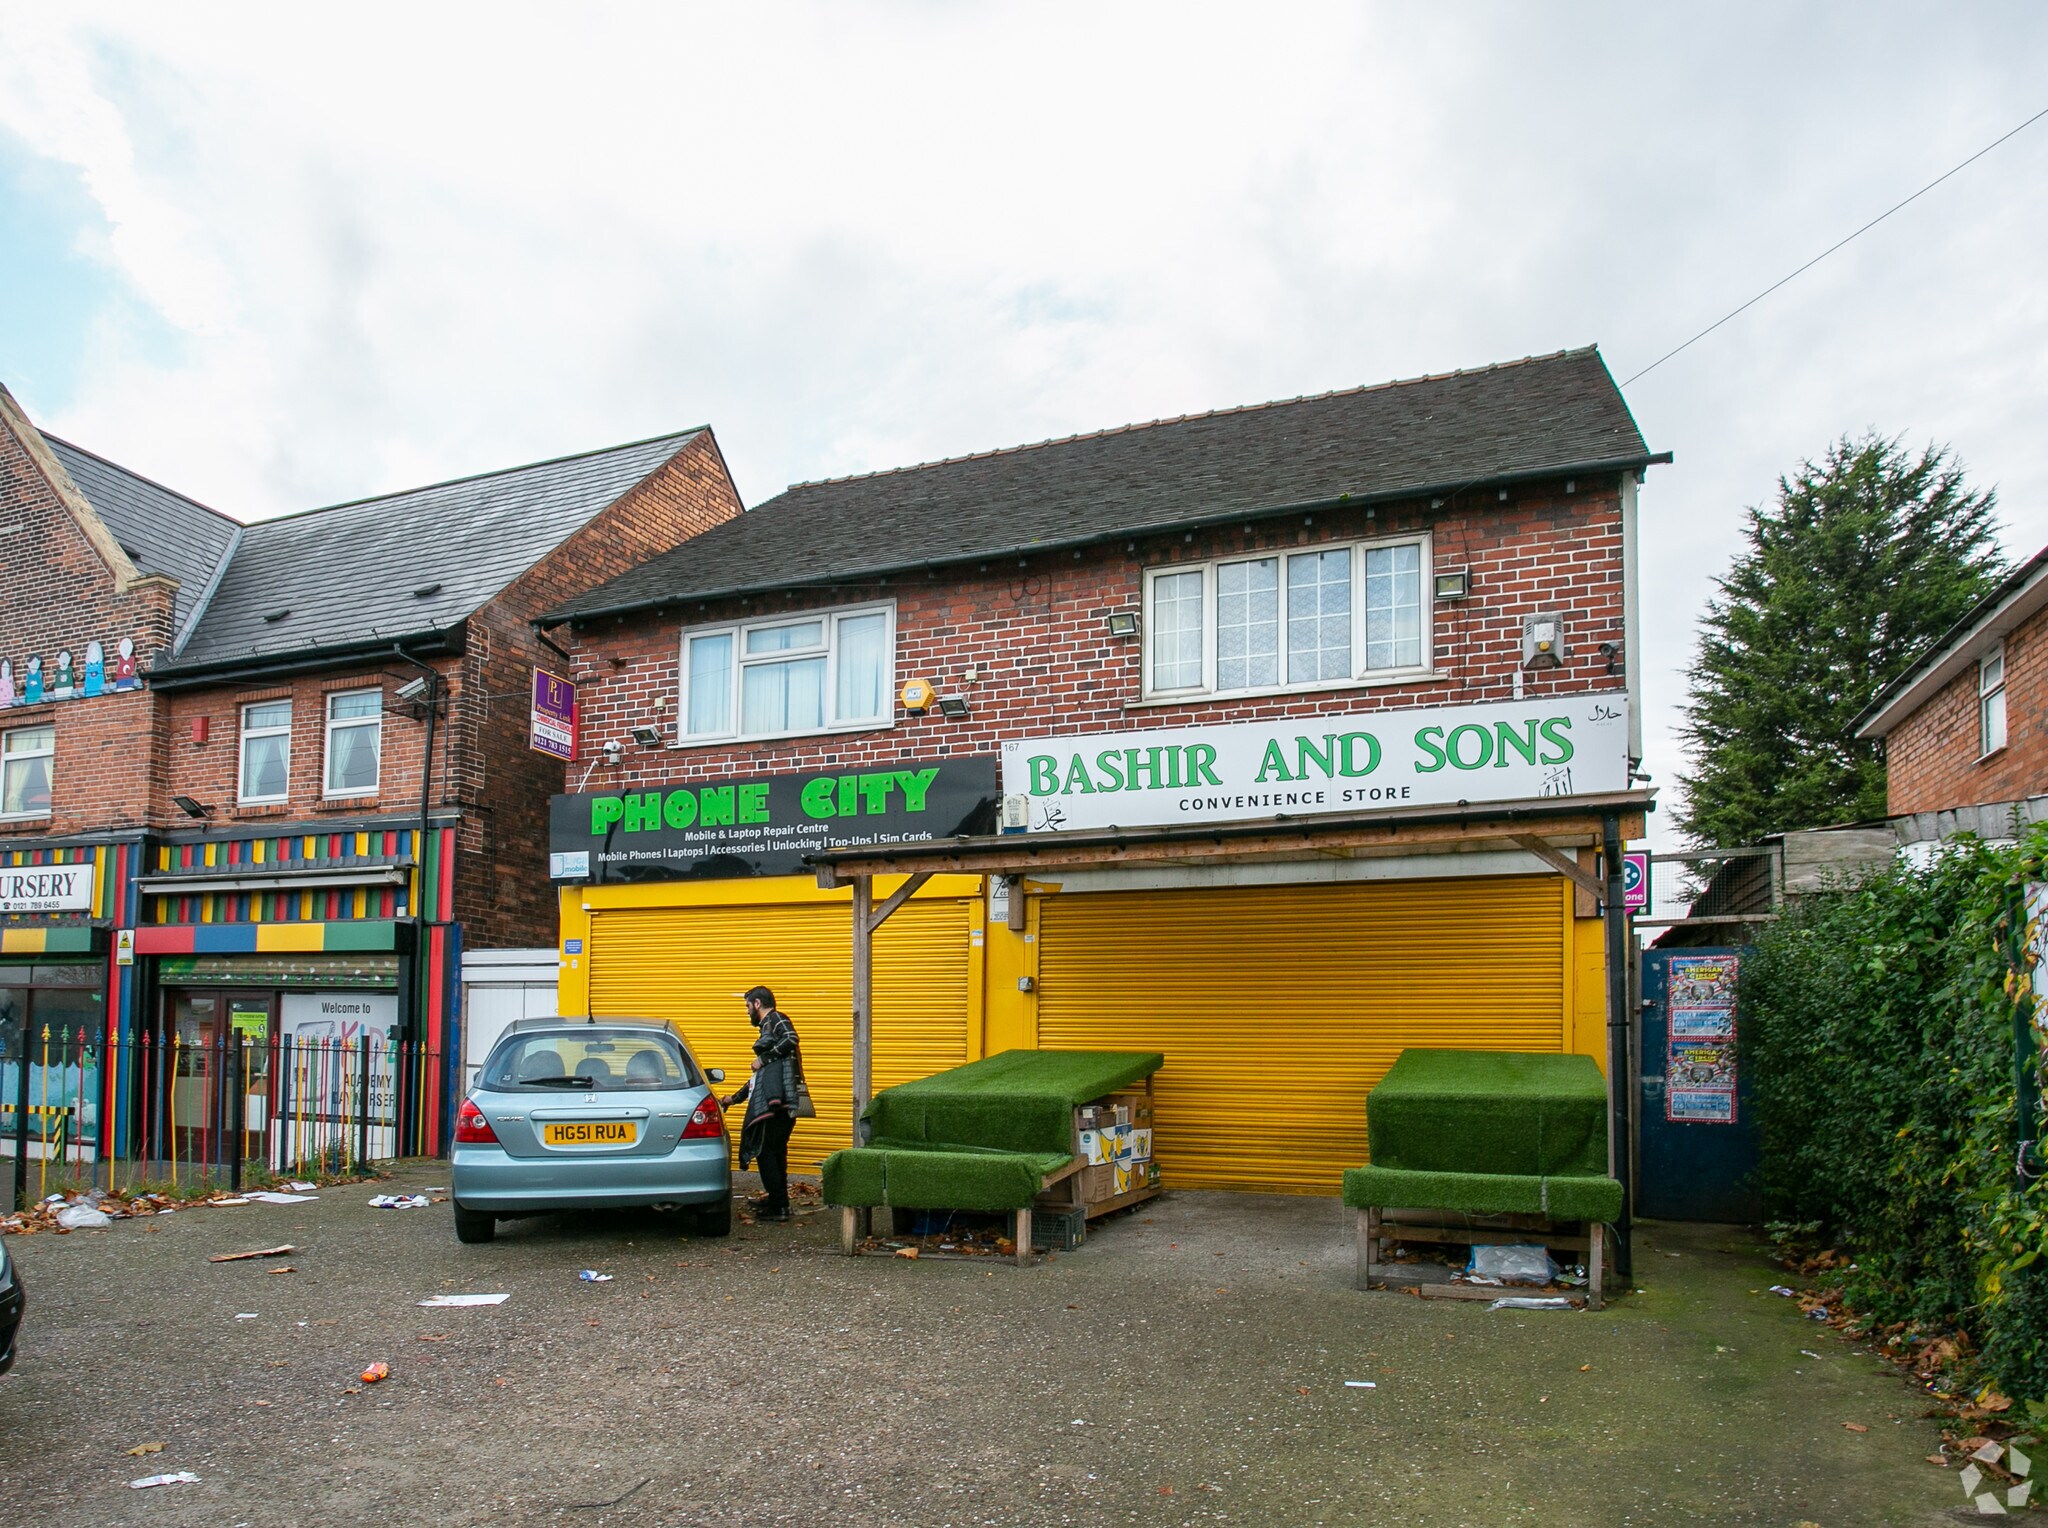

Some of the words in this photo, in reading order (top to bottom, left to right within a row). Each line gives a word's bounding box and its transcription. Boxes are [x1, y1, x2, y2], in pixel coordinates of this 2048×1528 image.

[560, 713, 571, 723] Link
[539, 727, 551, 736] FOR
[552, 732, 568, 743] SALE
[534, 736, 547, 746] 0121
[548, 740, 558, 750] 783
[559, 744, 571, 755] 1515
[1004, 743, 1019, 751] 167
[1026, 743, 1224, 797] BASHIR
[1254, 731, 1382, 783] AND
[1414, 716, 1574, 774] SONS
[591, 782, 770, 835] PHONE
[800, 768, 940, 819] CITY
[1179, 791, 1325, 811] CONVENIENCE
[1342, 786, 1411, 801] STORE
[685, 830, 716, 841] Mobile
[718, 829, 726, 839] &
[728, 828, 761, 840] Laptop
[763, 824, 795, 837] Repair
[796, 823, 829, 834] Centre
[597, 852, 628, 862] Mobile
[629, 849, 662, 860] Phones
[668, 847, 703, 858] Laptops
[710, 842, 765, 855] Accessories
[772, 838, 822, 851] Unlocking
[829, 836, 872, 847] Top-Ups
[879, 833, 900, 843] Sim
[902, 831, 933, 842] Cards
[0, 872, 77, 899] URSERY
[30, 901, 42, 909] 789
[43, 901, 60, 909] 6455
[321, 1002, 361, 1014] Welcome
[362, 1003, 371, 1014] to
[345, 1073, 392, 1088] ACAEMY
[554, 1126, 590, 1141] HG51
[595, 1125, 627, 1139] RUA
